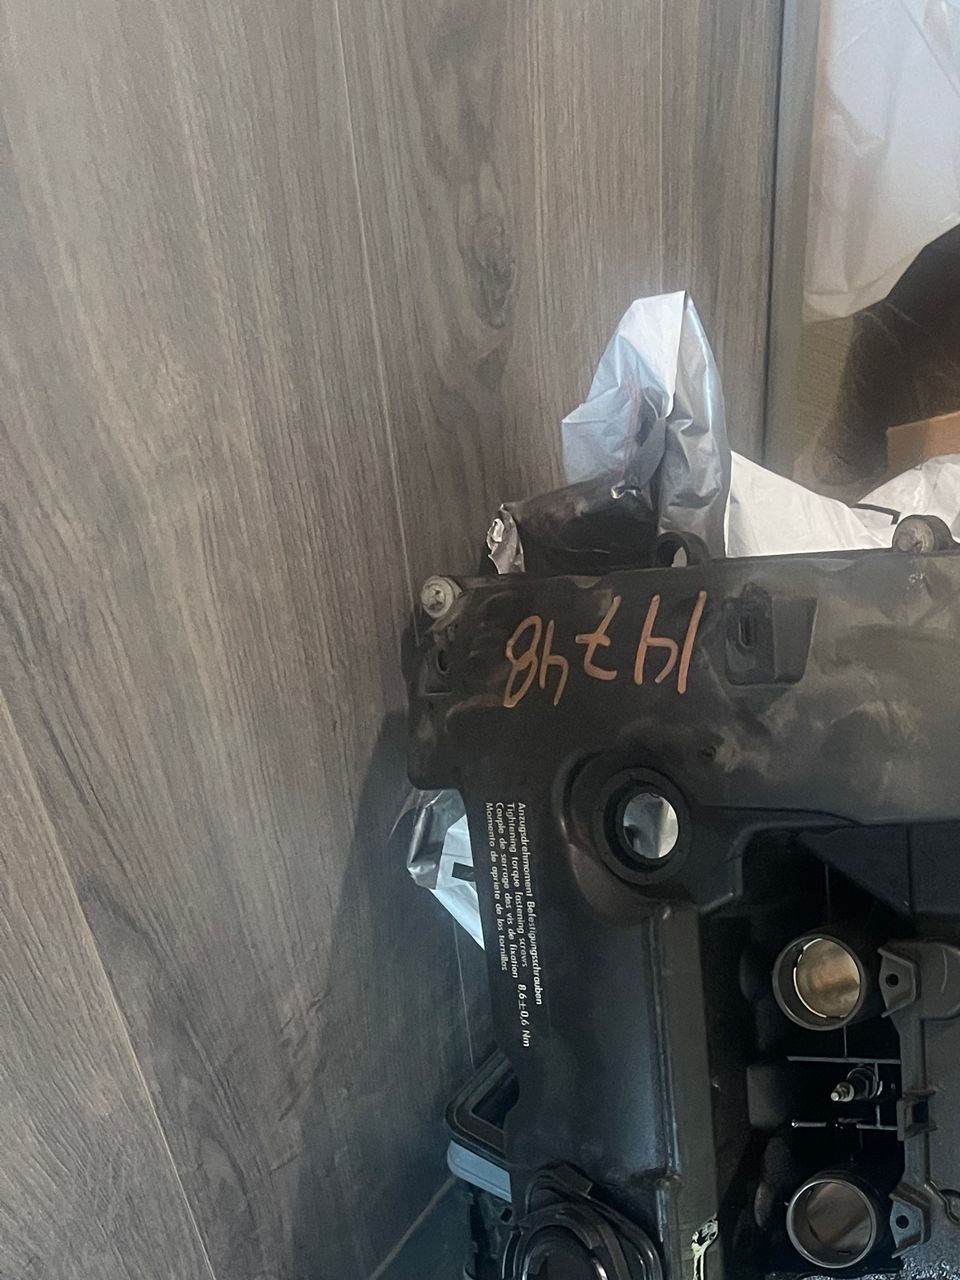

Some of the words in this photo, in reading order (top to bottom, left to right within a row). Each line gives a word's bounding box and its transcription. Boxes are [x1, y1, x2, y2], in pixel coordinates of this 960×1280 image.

[485, 802, 496, 847] Momento
[495, 802, 506, 834] Couple
[506, 803, 517, 853] Tightening
[490, 850, 499, 863] de
[499, 837, 508, 850] de
[500, 853, 510, 889] serrage
[511, 856, 520, 888] torque
[495, 903, 504, 915] de
[505, 892, 513, 909] des
[515, 891, 525, 934] fastening
[518, 802, 533, 897] Anzugsdrehmoment
[526, 901, 543, 1004] Befestigungsschrauben
[497, 918, 505, 931] los
[506, 912, 514, 925] vis
[507, 928, 516, 941] de
[498, 935, 508, 971] tornillos
[509, 944, 518, 979] fixation
[519, 938, 527, 968] screws
[522, 1029, 532, 1048] Nm
